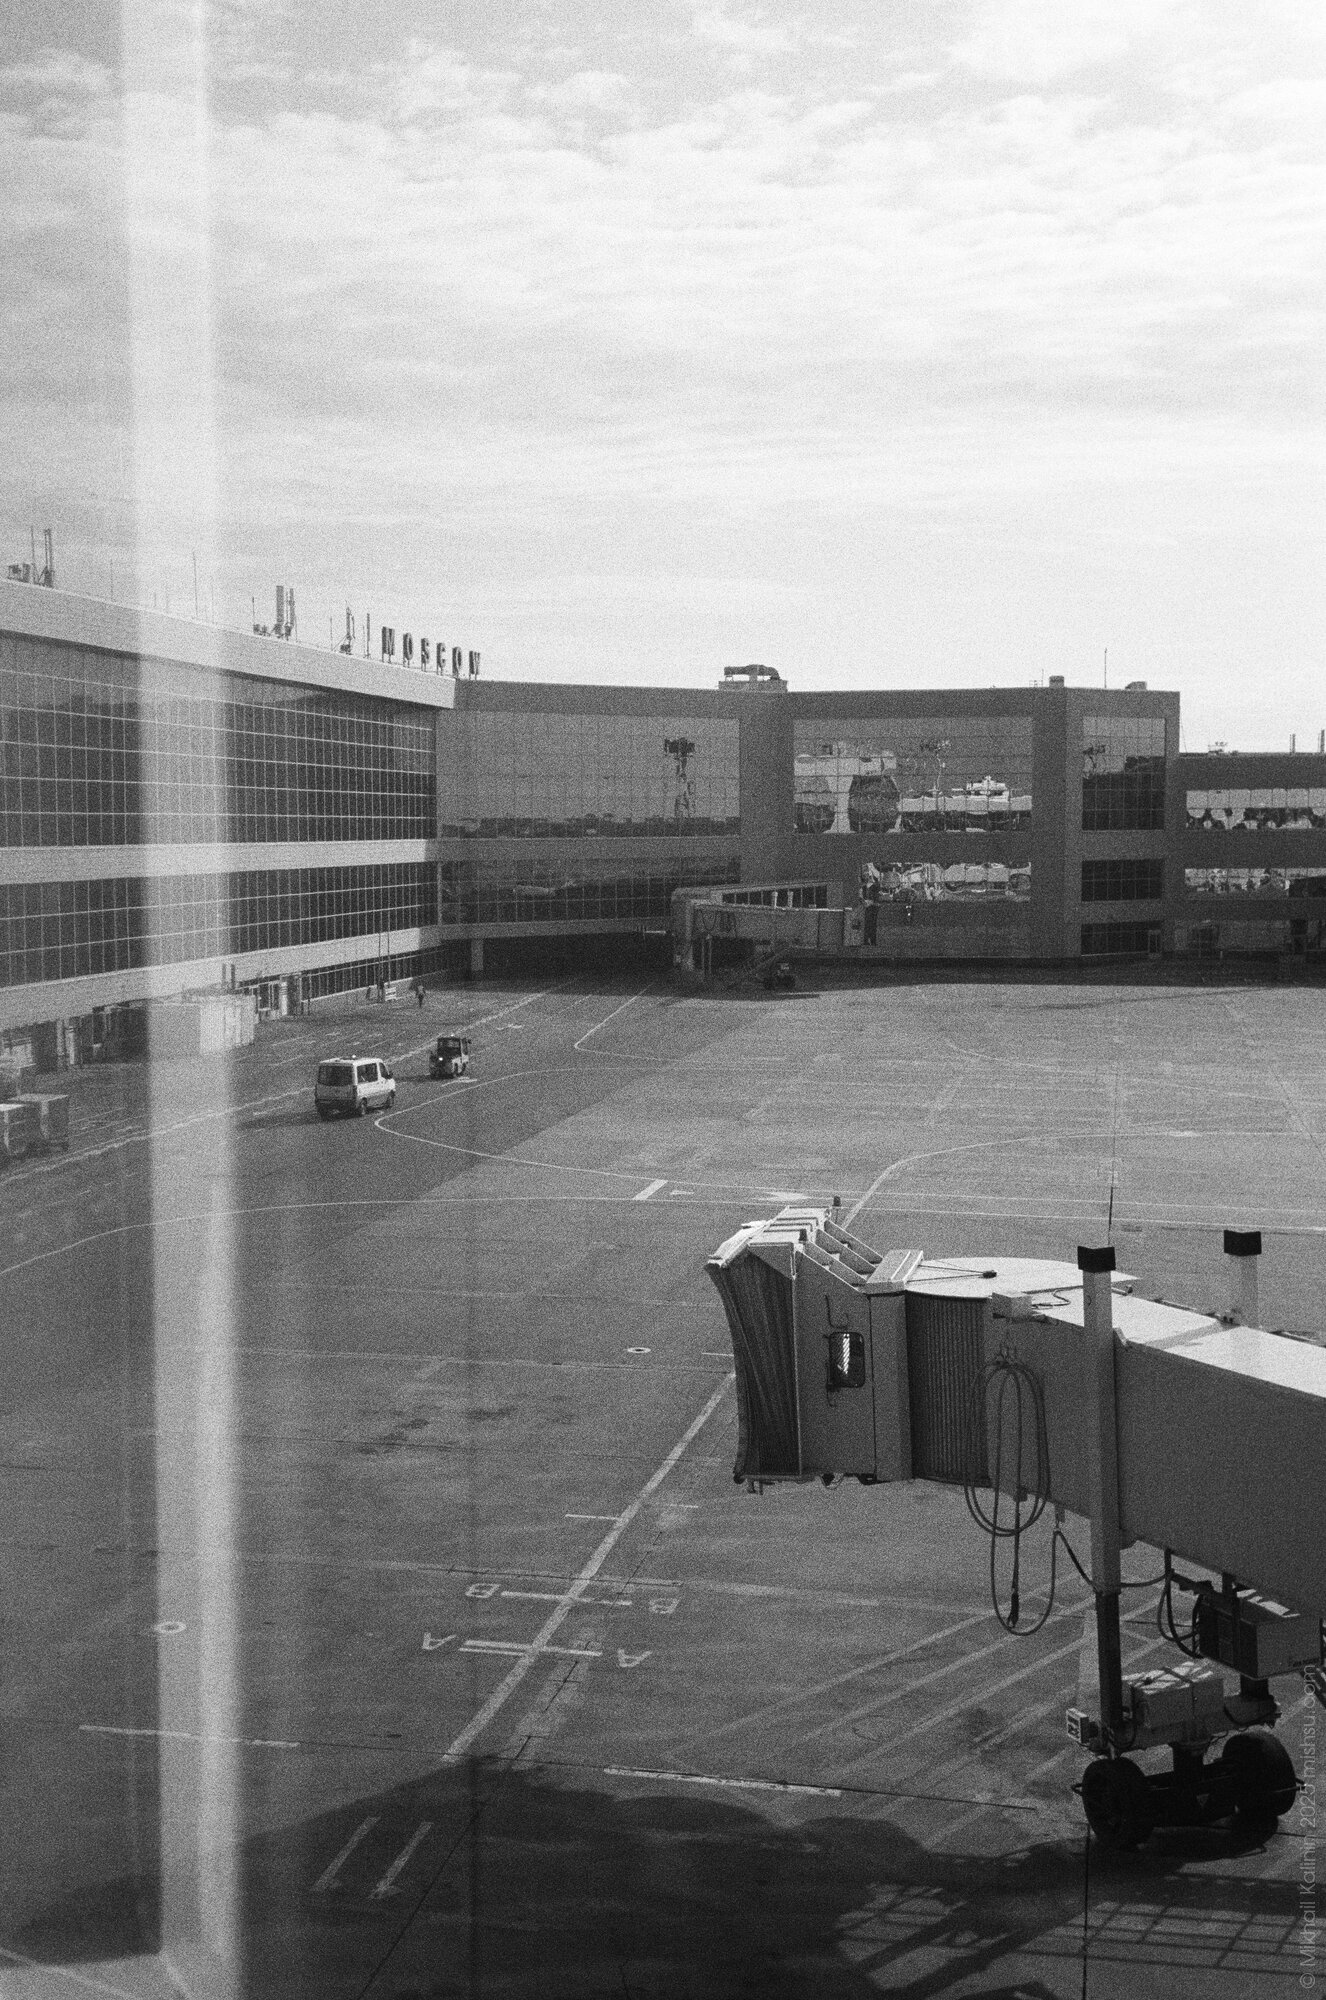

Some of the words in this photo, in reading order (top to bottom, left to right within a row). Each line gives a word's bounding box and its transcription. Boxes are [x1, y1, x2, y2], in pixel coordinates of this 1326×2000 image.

[381, 626, 481, 676] MOSCOW
[465, 1583, 500, 1598] B
[648, 1598, 680, 1615] B
[422, 1632, 457, 1651] A
[617, 1648, 653, 1668] A
